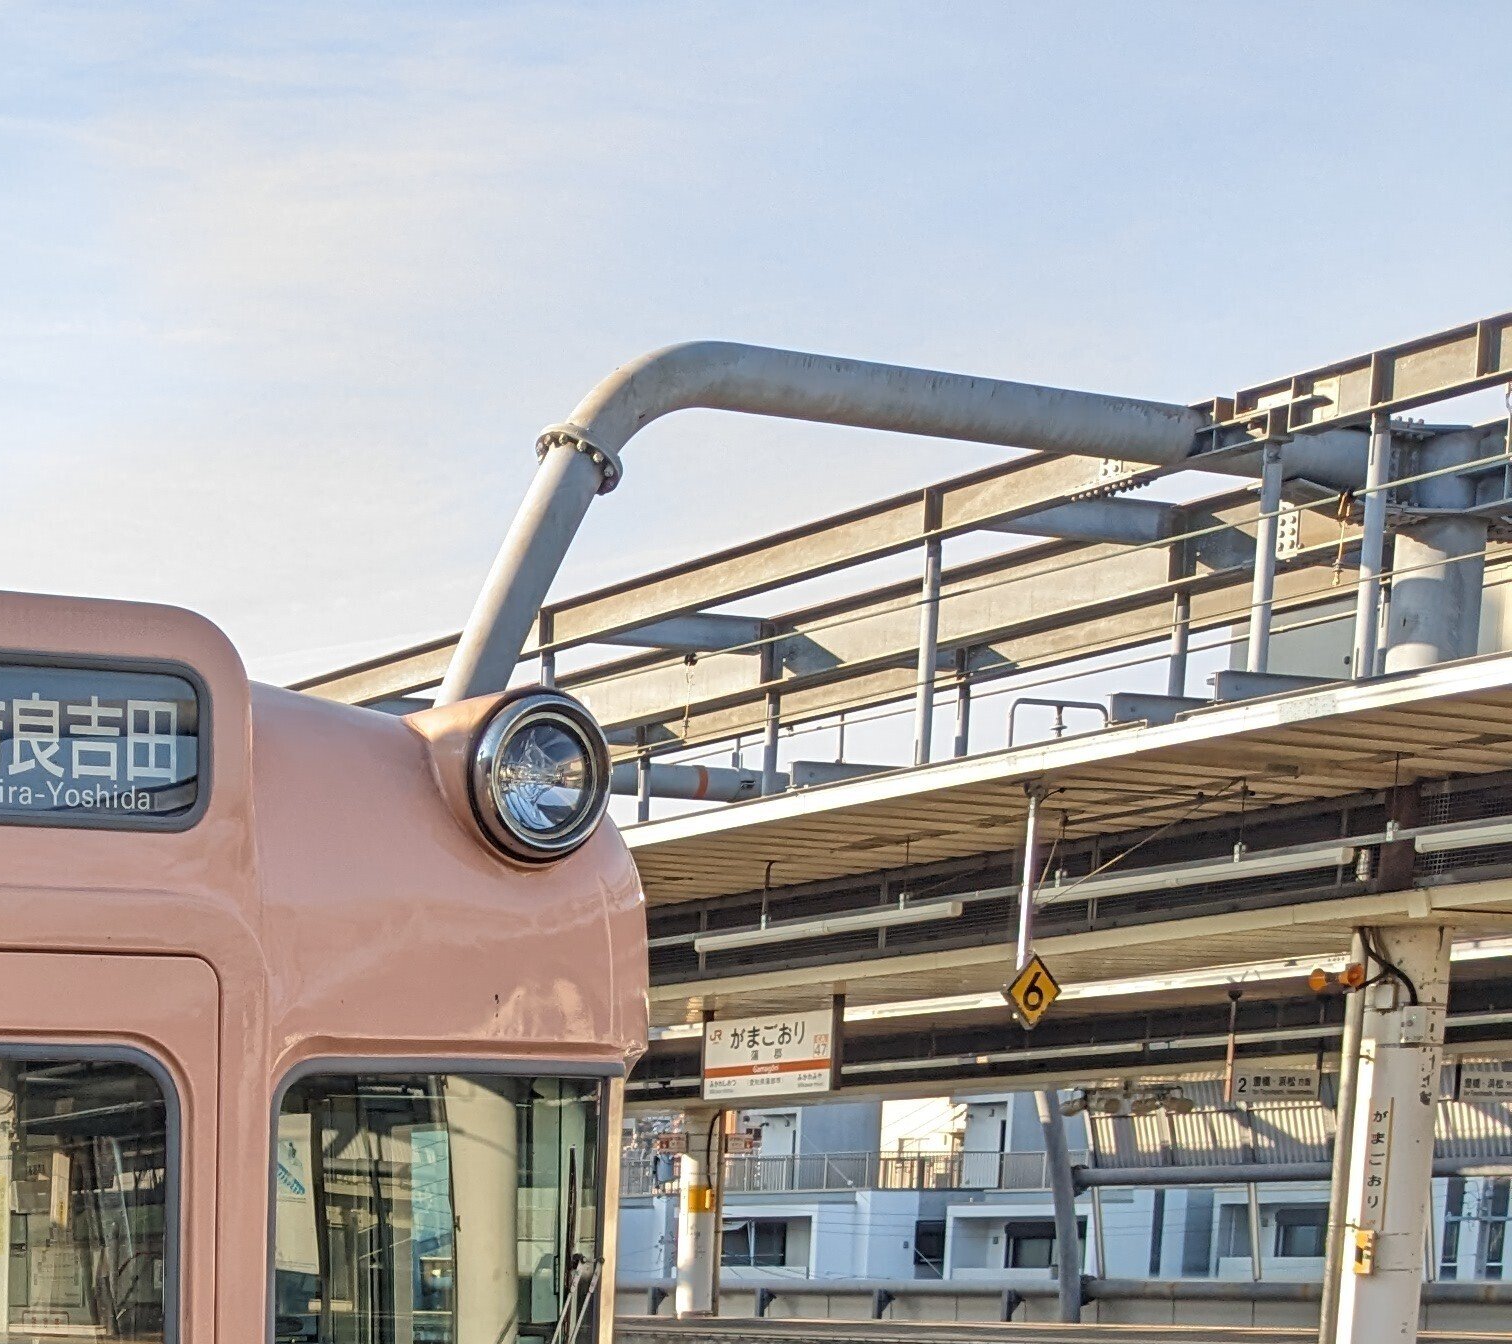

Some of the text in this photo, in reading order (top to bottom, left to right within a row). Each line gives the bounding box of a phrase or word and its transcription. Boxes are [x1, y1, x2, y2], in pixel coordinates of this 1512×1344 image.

[1023, 972, 1043, 1011] 6
[709, 1029, 723, 1042] JR
[730, 1021, 805, 1049] がまごおり
[814, 1043, 828, 1056] 47
[1238, 1077, 1247, 1093] 2
[1367, 1110, 1388, 1208] がまごおり
